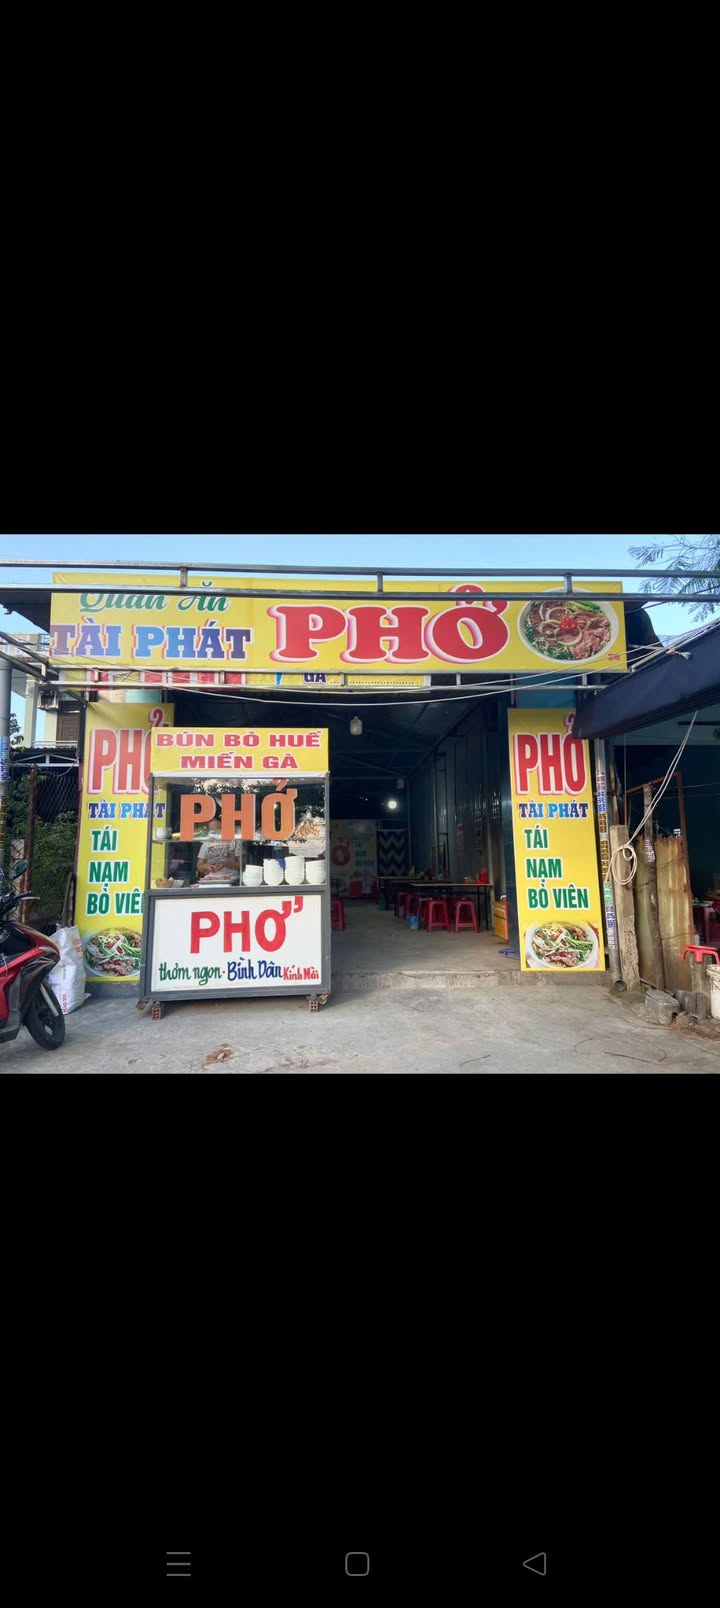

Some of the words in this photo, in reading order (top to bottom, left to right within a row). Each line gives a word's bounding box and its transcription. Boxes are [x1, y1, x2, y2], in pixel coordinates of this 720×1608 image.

[267, 584, 509, 664] PHỞ
[50, 617, 122, 658] TÀI
[131, 619, 251, 660] PHÁT
[156, 731, 215, 747] BÚN
[224, 731, 260, 747] BÒ
[269, 730, 322, 747] HUẾ
[181, 752, 253, 769] MIẾN
[262, 753, 299, 769] GÀ
[88, 799, 116, 818] TÀI
[179, 777, 298, 842] PHỞ
[518, 800, 544, 818] TÀI
[548, 800, 588, 819] PHÁT
[91, 827, 118, 852] TÁI
[524, 825, 548, 849] TÁI
[89, 861, 129, 887] NẠM
[526, 857, 562, 882] NẠM
[87, 887, 110, 914] BÒ
[528, 879, 548, 909] BÒ
[553, 884, 589, 909] VIÊN
[193, 965, 223, 986] ngon
[227, 957, 257, 982] Bình
[257, 960, 284, 980] Dân
[283, 965, 303, 981] Kính
[303, 966, 319, 980] Mời
